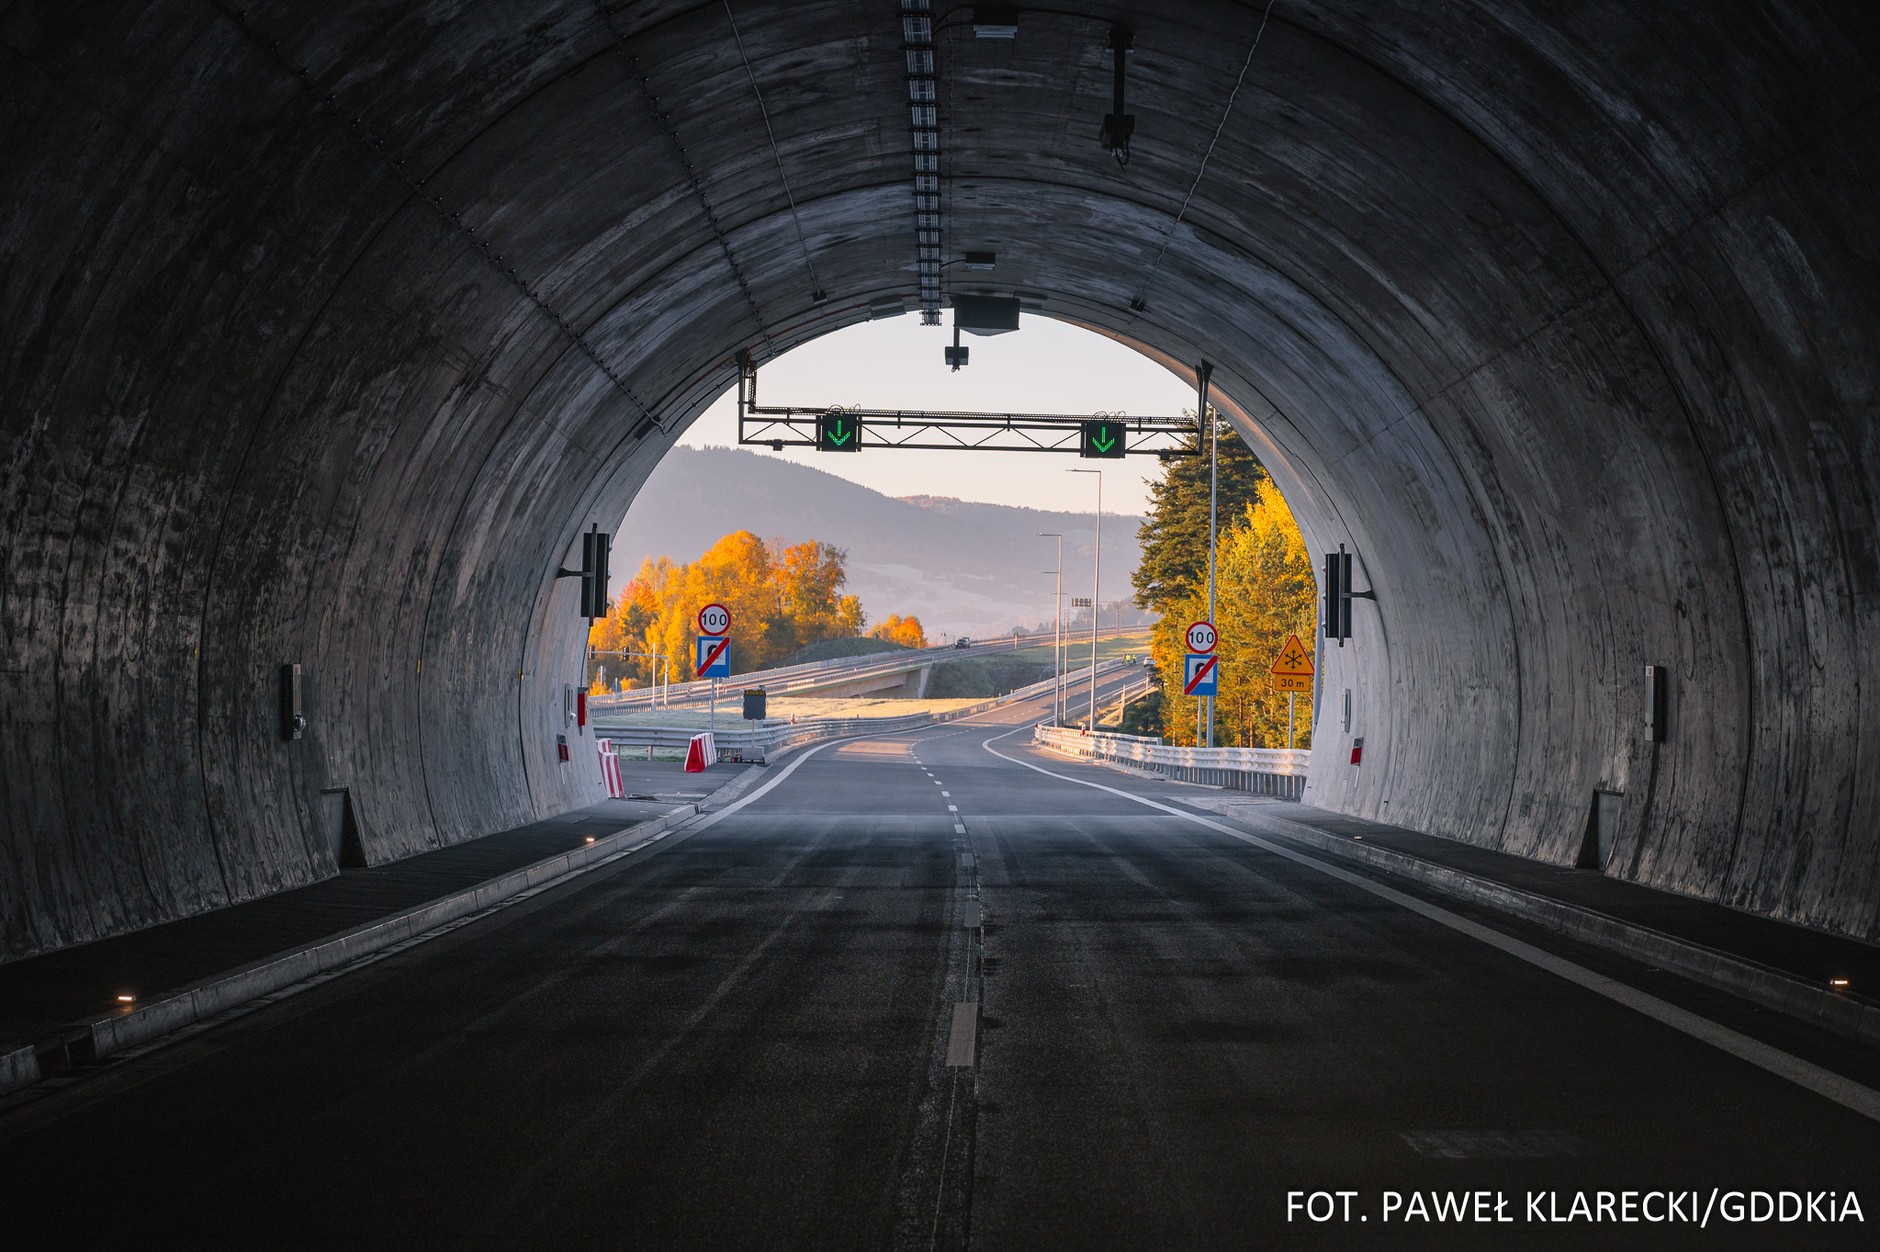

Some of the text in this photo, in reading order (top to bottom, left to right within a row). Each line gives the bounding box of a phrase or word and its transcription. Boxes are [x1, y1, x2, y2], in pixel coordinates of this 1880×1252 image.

[702, 613, 727, 626] 100
[1189, 631, 1214, 644] 100
[1281, 679, 1294, 687] 30
